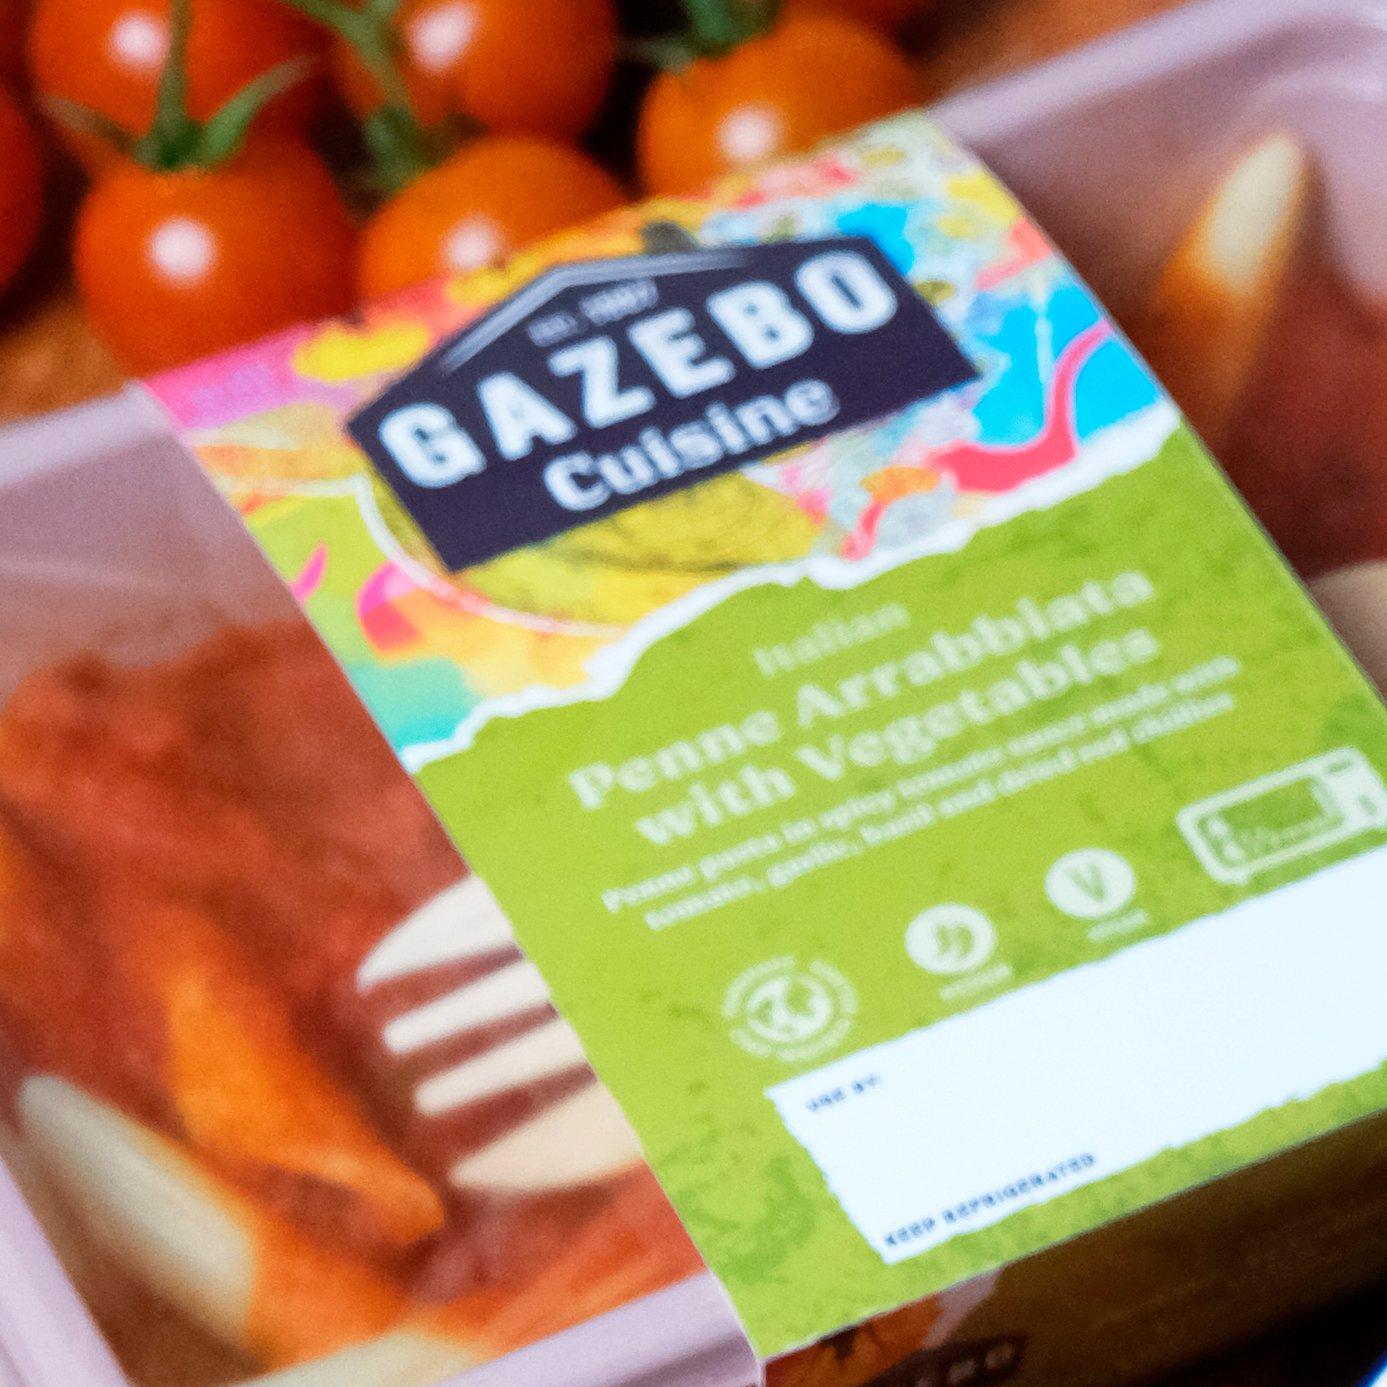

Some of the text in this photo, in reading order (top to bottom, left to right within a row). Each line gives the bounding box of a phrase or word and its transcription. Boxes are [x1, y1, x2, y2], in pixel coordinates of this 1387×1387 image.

[378, 250, 898, 489] GAZEBO
[542, 378, 841, 511] Cuisine
[568, 572, 1152, 809] Penne Arrabbiata
[636, 630, 1156, 845] with Vegetables
[884, 1151, 1095, 1247] KEEP REFRIGERATED
